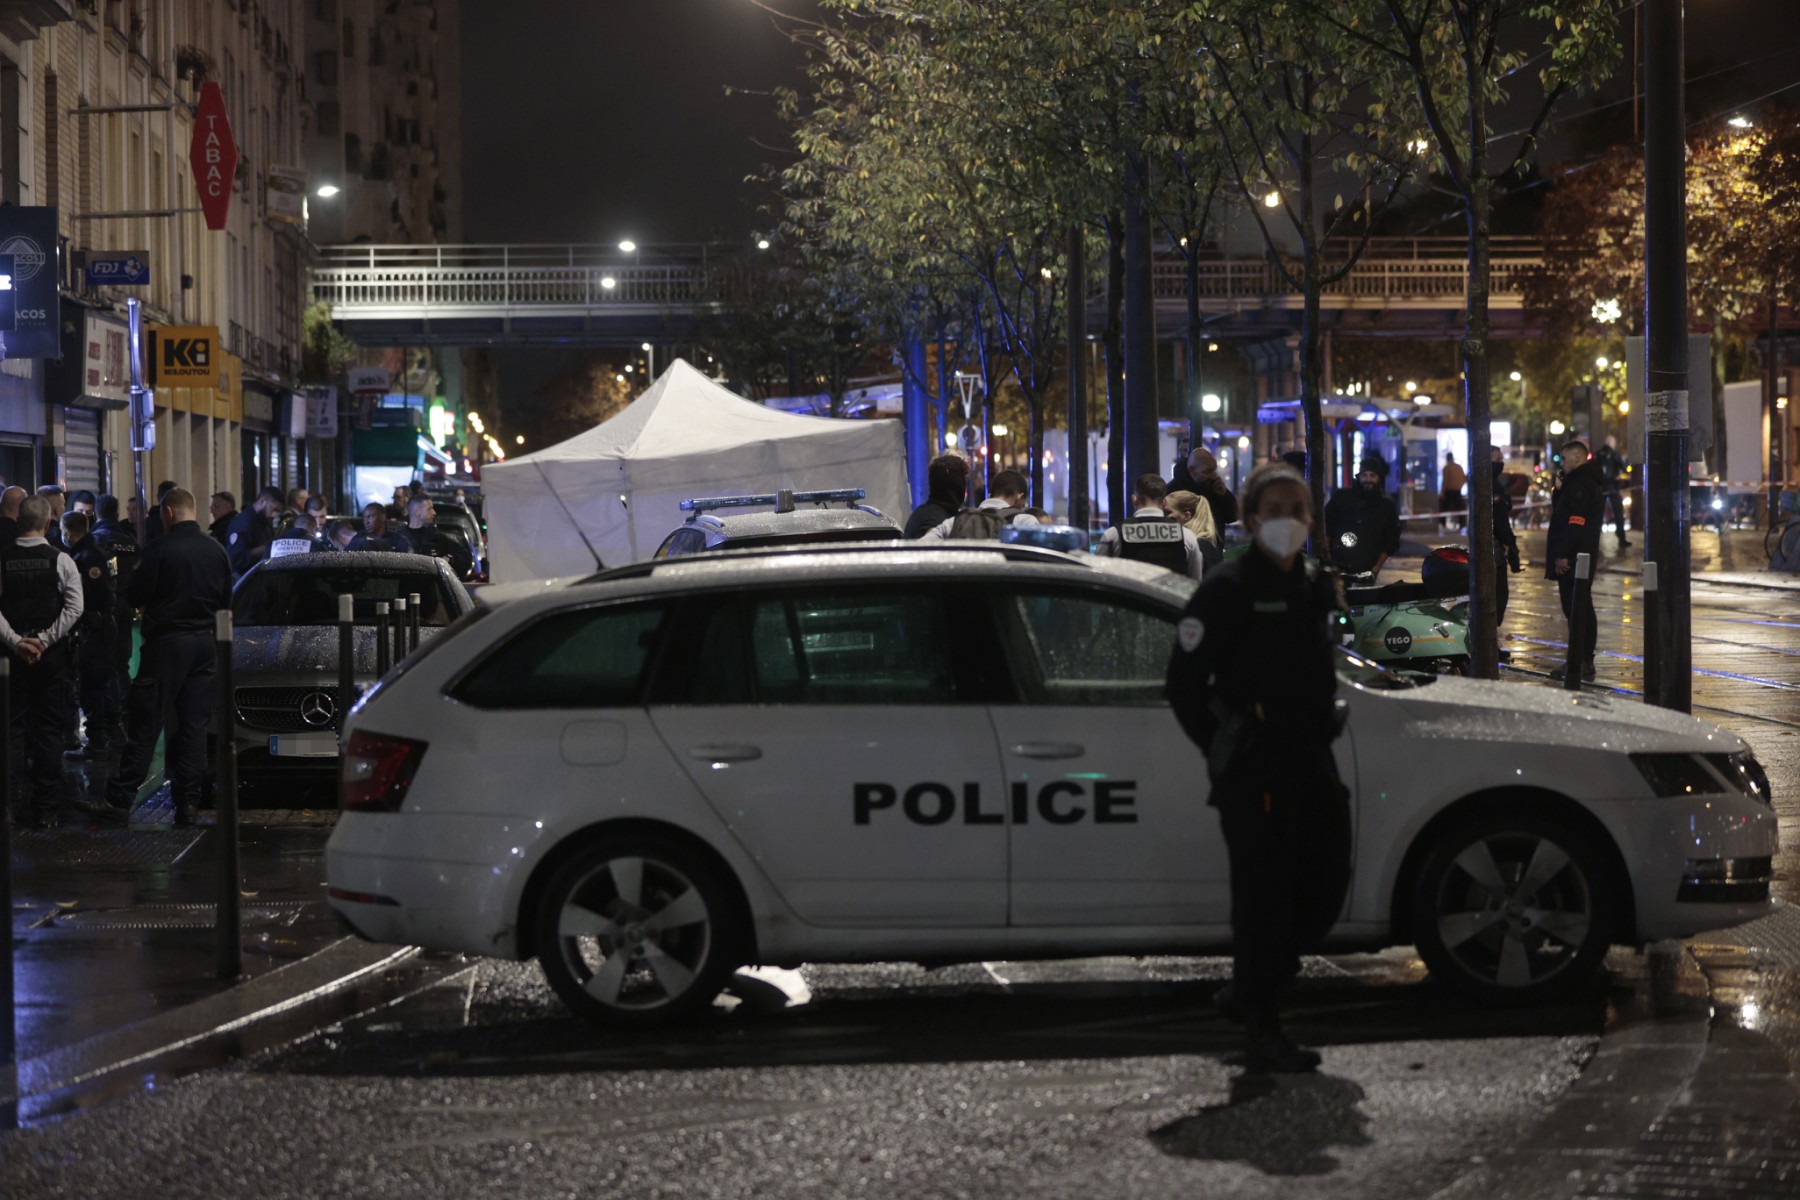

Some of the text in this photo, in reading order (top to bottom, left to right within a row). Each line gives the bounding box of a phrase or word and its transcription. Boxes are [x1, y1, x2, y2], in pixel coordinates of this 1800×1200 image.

[205, 115, 221, 196] TABAC
[94, 262, 119, 274] FDJ
[1125, 525, 1178, 540] POLICE
[113, 543, 136, 552] POLICE
[8, 560, 47, 569] POLICE
[1386, 636, 1410, 645] YEGO
[853, 781, 1138, 825] POLICE
